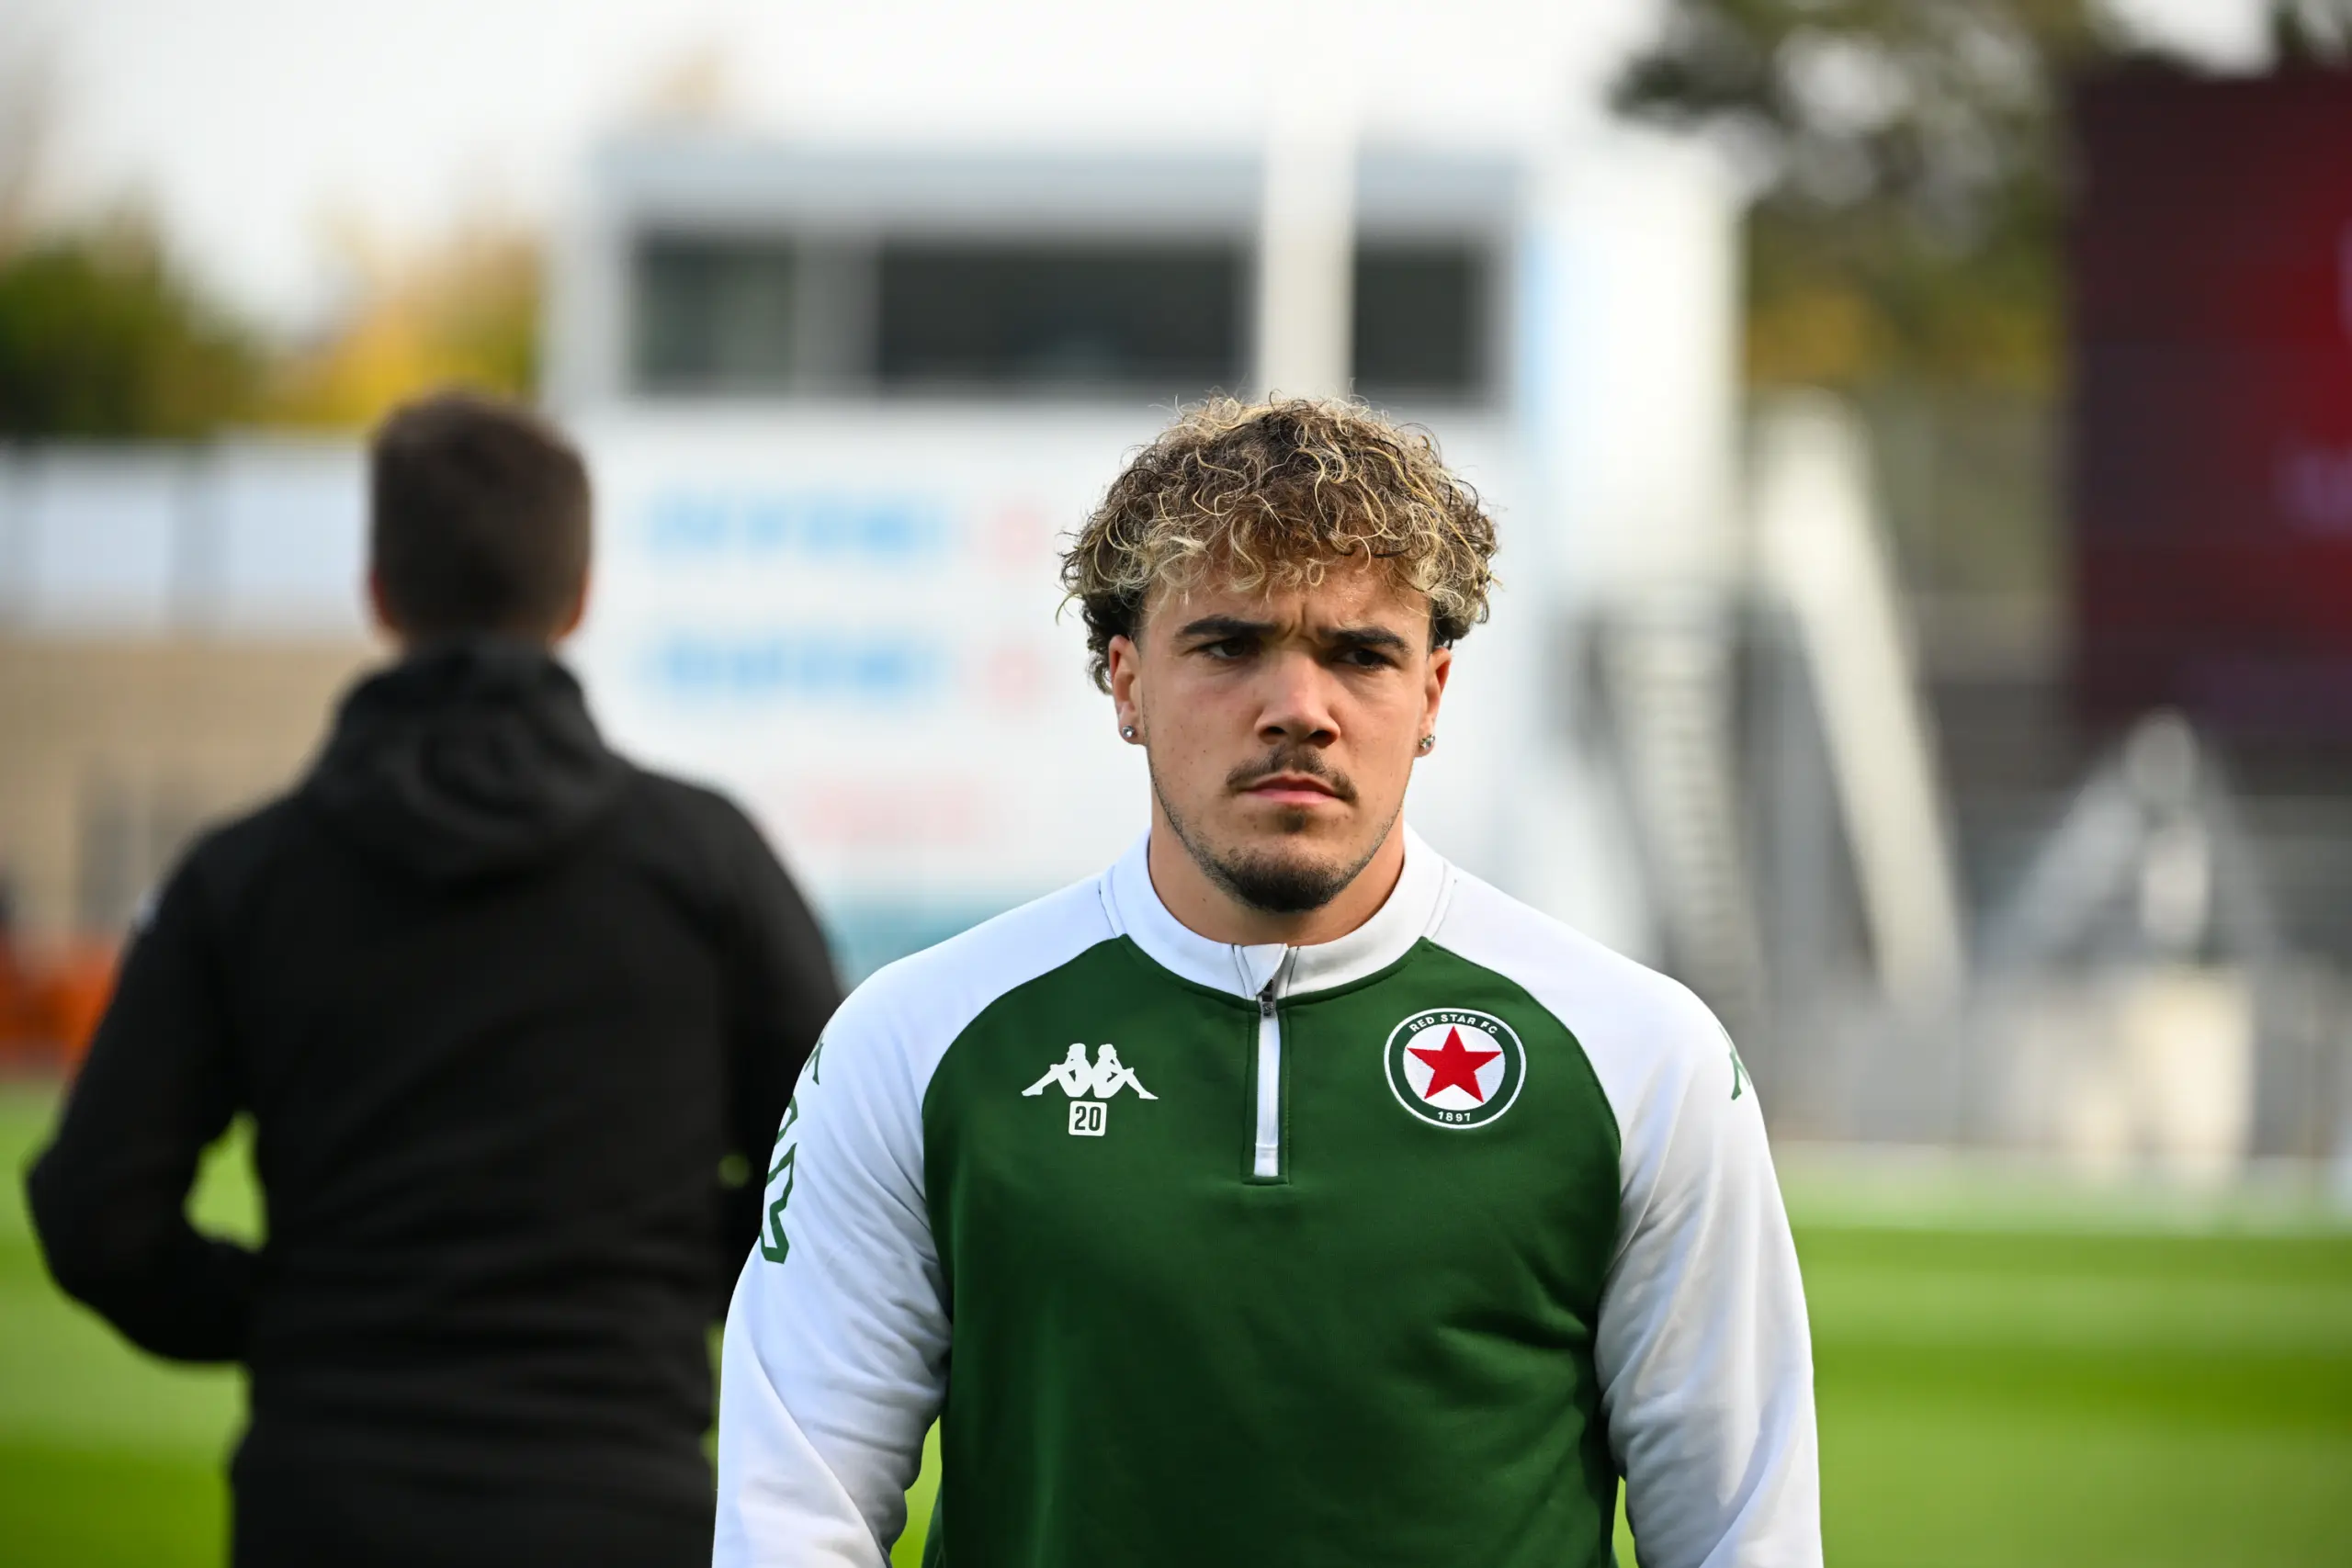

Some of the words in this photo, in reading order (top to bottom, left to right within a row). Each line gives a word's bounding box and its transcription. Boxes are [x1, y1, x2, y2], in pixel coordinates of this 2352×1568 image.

[1408, 1016, 1435, 1032] RED
[1441, 1013, 1476, 1025] STAR
[1480, 1021, 1498, 1034] FC
[1074, 1105, 1102, 1132] 20
[1437, 1111, 1471, 1122] 1897
